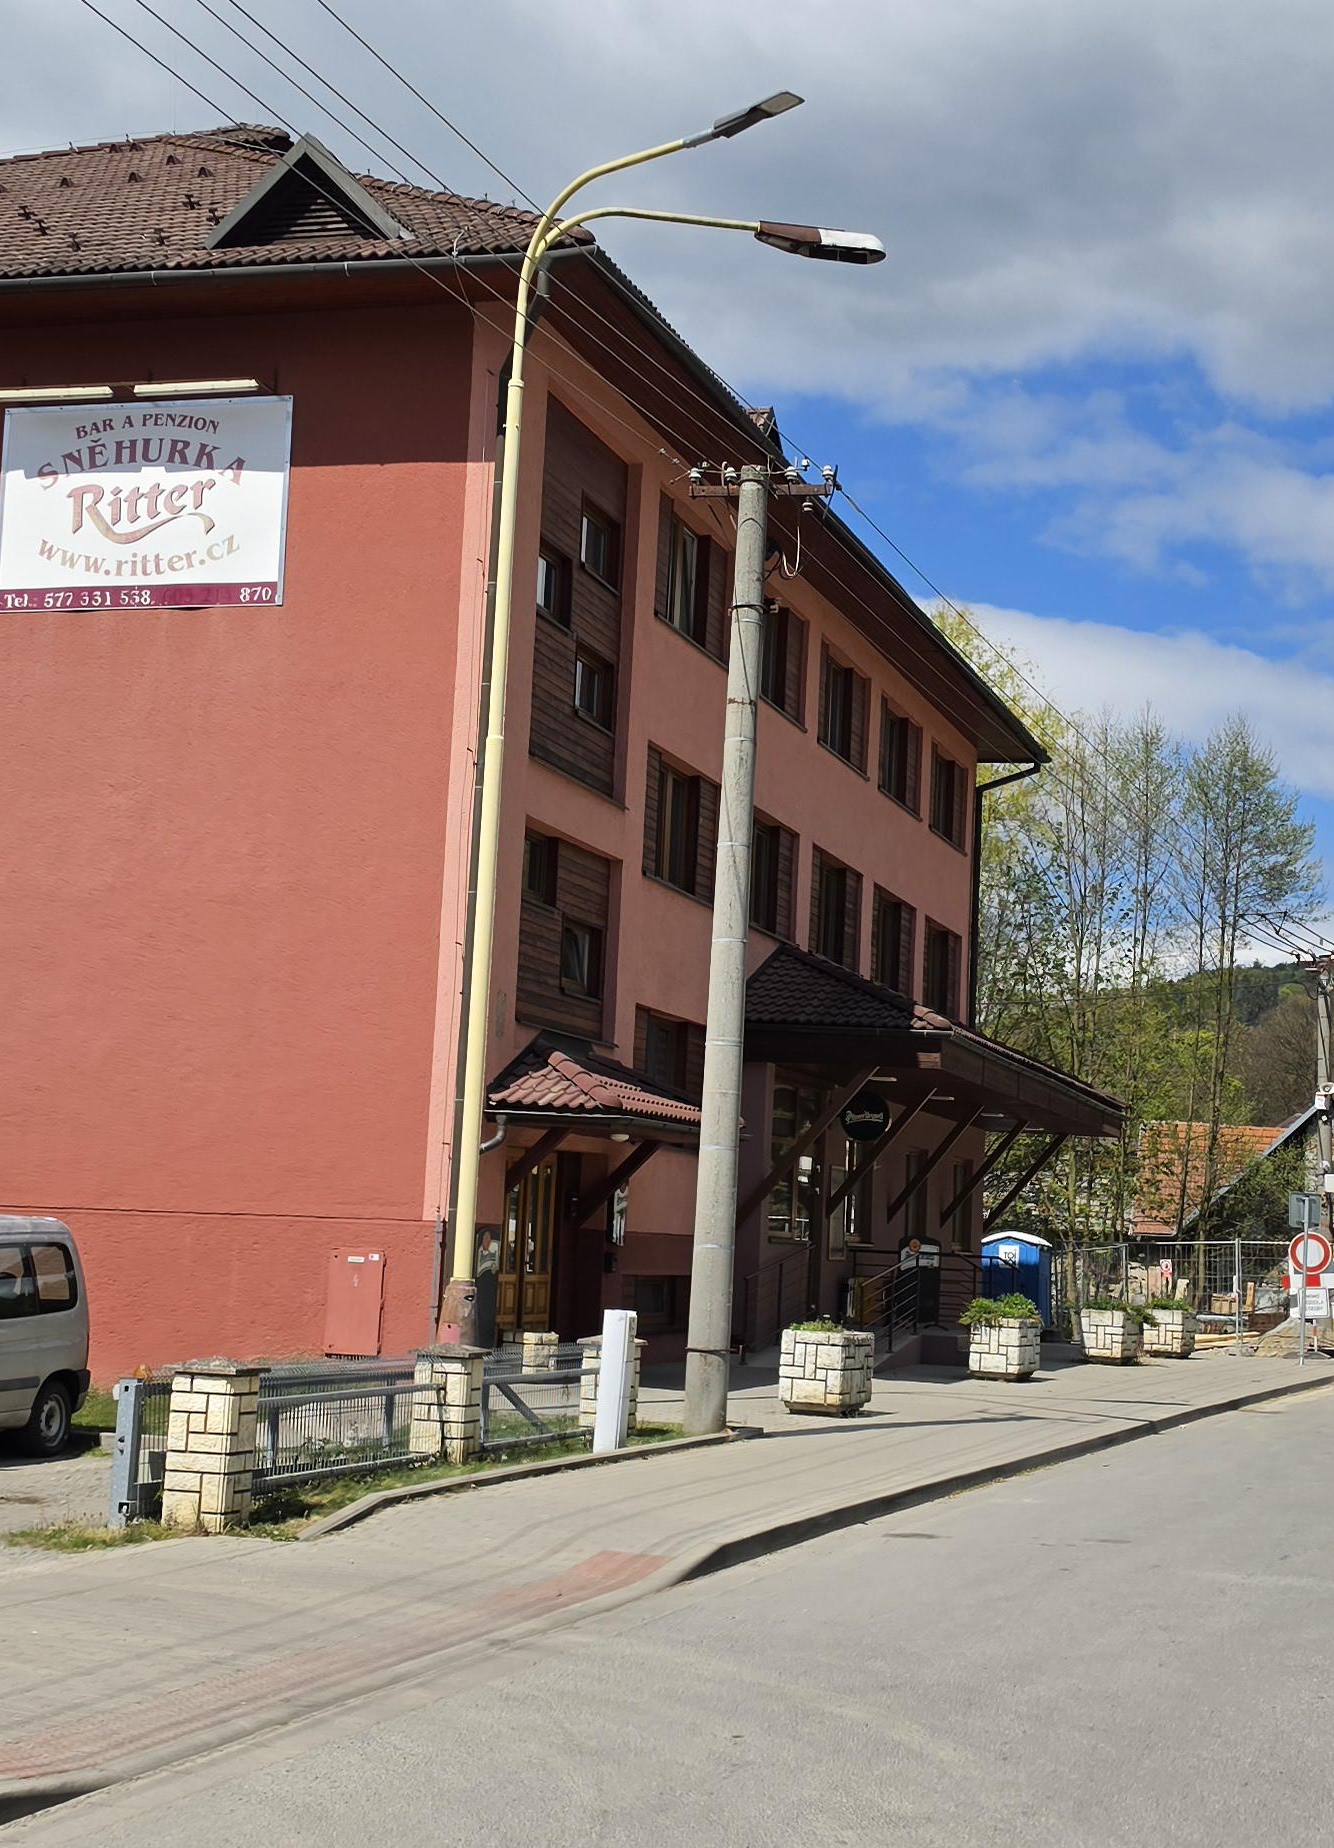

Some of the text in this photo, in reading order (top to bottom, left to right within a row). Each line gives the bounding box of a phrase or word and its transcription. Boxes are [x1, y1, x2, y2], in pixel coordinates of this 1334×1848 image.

[75, 413, 220, 440] BAR A PENZION
[37, 438, 247, 490] SNĚHURKA
[67, 478, 217, 545] Ritter
[38, 534, 240, 577] www.ritter.cz
[43, 591, 73, 608] 577
[80, 590, 111, 606] 331
[239, 586, 272, 603] 870
